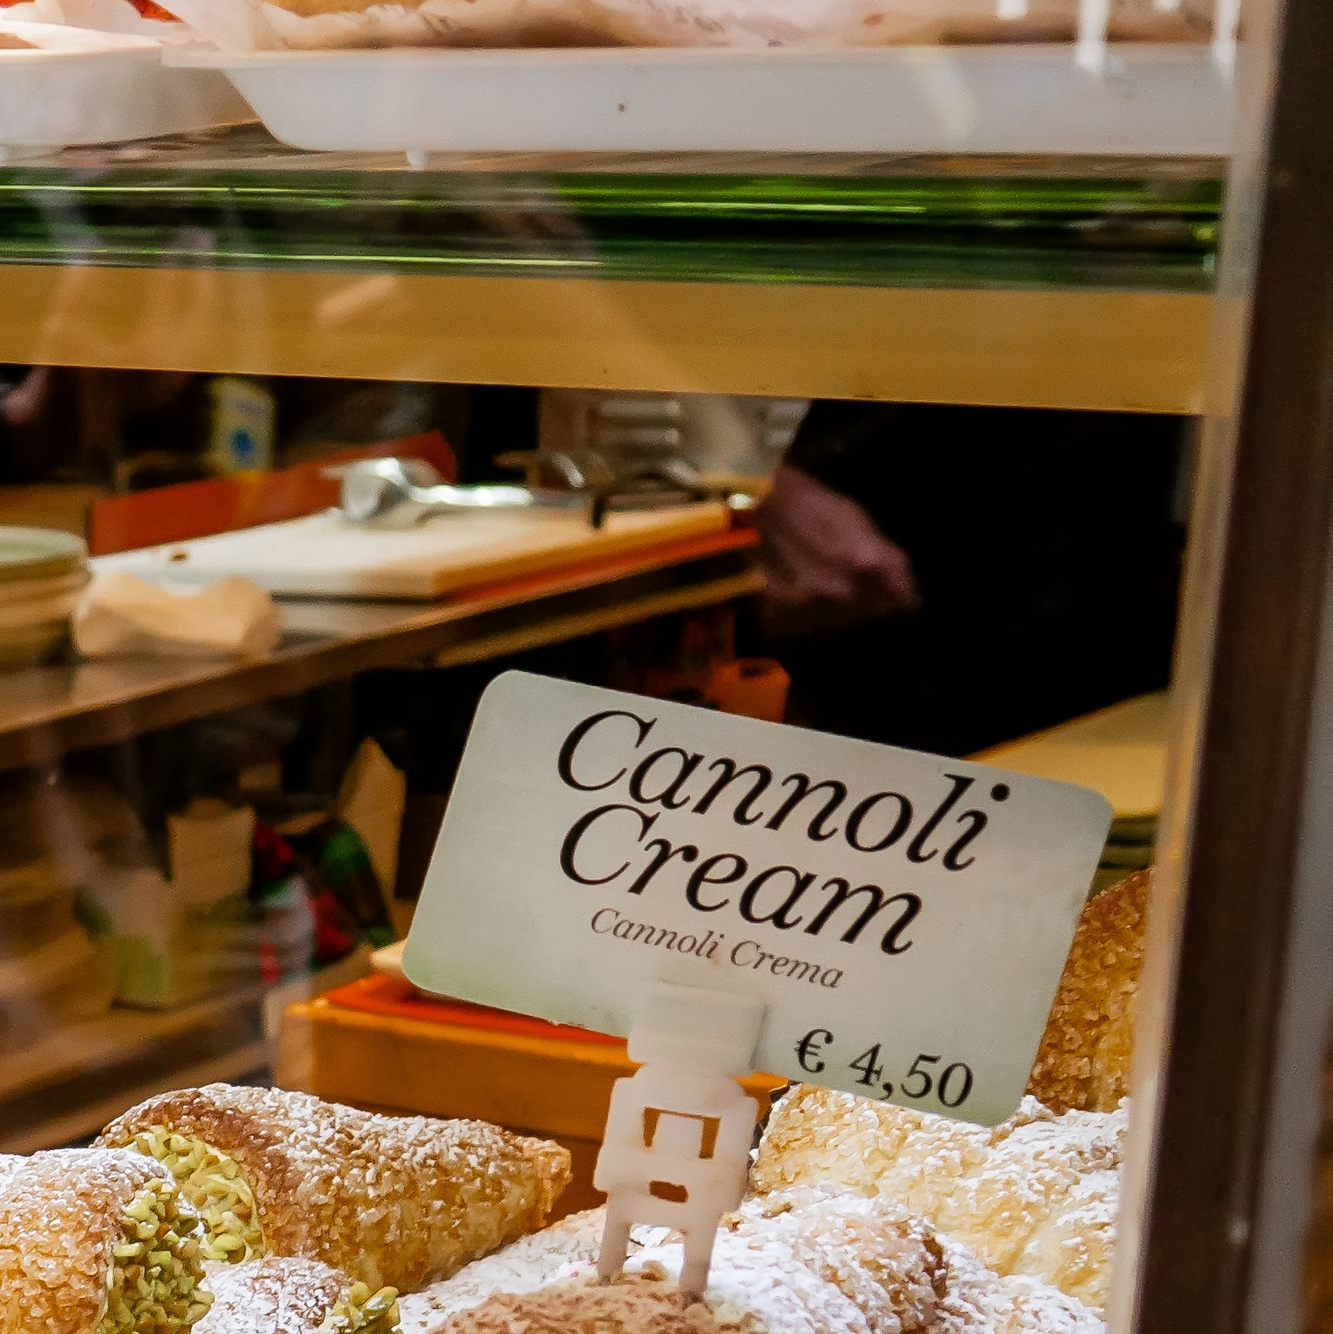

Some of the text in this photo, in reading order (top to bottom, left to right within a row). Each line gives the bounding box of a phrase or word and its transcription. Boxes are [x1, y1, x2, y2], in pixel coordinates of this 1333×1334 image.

[556, 709, 1011, 872] Cannoli
[558, 803, 923, 956] Cream
[589, 907, 845, 989] Cannoli Crema
[794, 1028, 974, 1110] € 4,50
